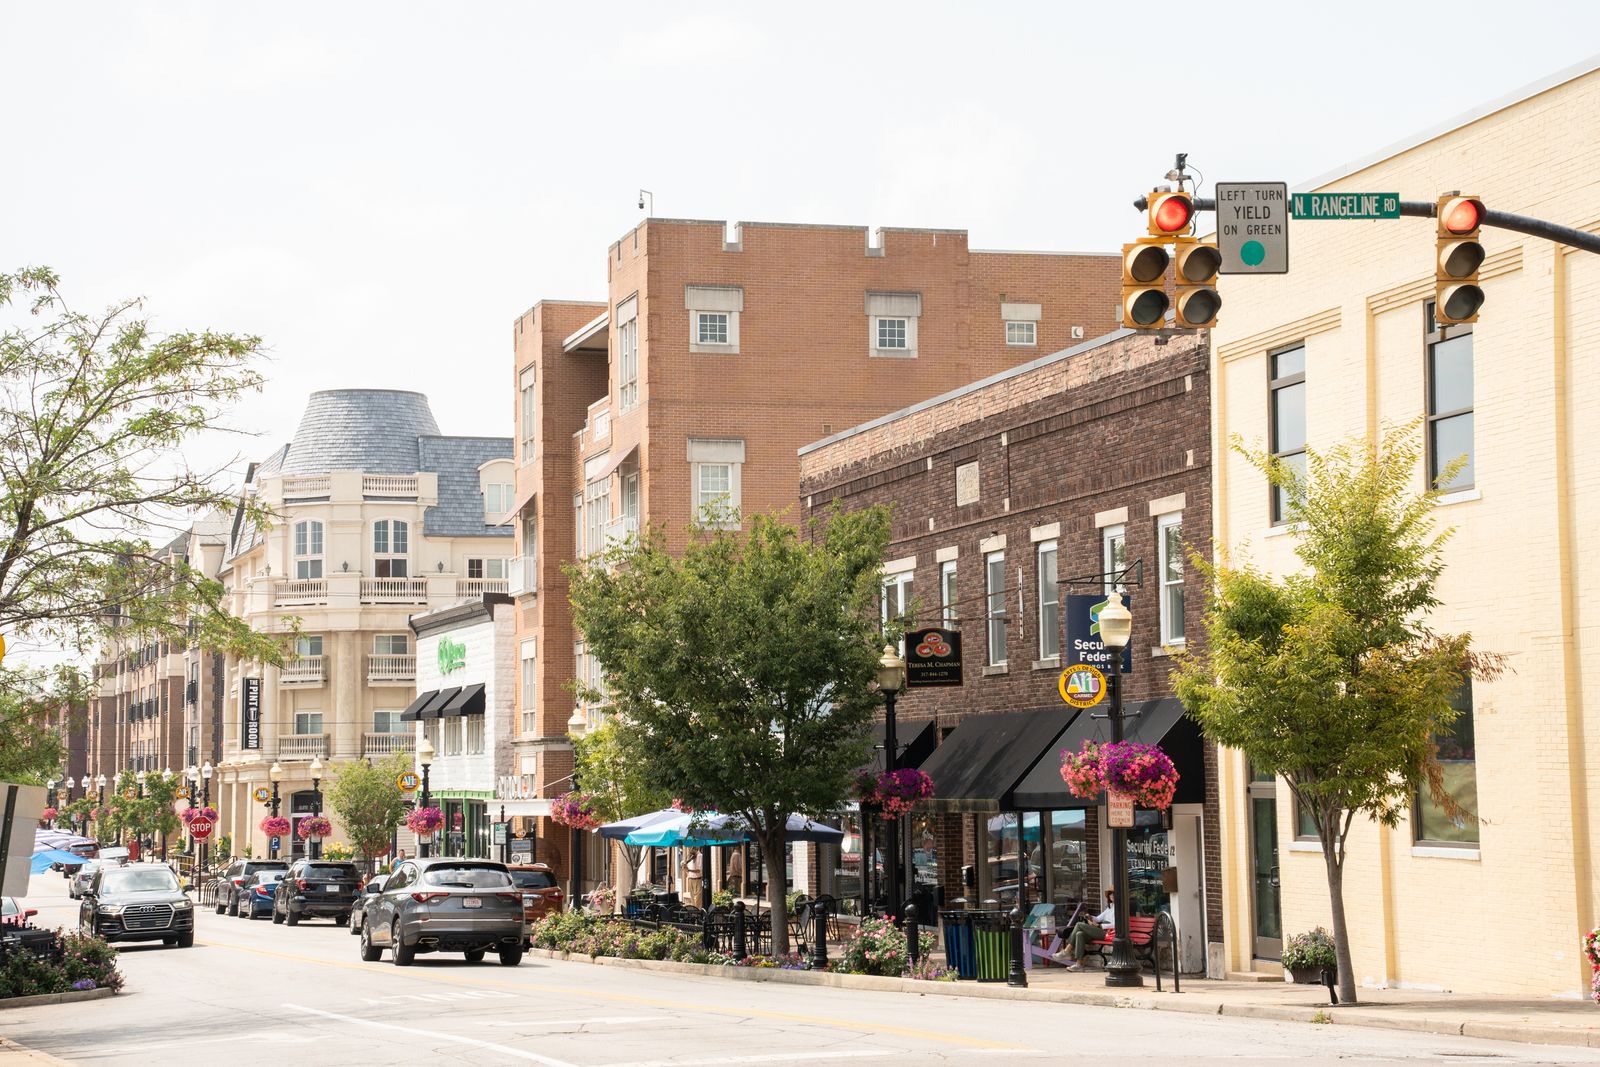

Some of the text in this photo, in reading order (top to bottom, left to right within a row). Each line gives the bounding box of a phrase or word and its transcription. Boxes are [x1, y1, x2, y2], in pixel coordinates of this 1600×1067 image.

[1220, 190, 1283, 201] LEFT TURN
[1294, 195, 1396, 217] N. RANGELINE RD
[1233, 205, 1271, 220] YIELD
[1223, 224, 1282, 236] ON GREEN
[1074, 639, 1103, 650] Secu
[1079, 651, 1112, 662] Feder
[1063, 667, 1076, 679] ARTS
[1081, 665, 1102, 679] DESIGN
[248, 686, 259, 707] PINT
[1069, 698, 1096, 707] DISTRICT
[248, 721, 258, 748] ROOM
[1110, 801, 1132, 809] PARKING
[190, 823, 211, 833] STOP
[272, 837, 279, 846] P
[1127, 839, 1169, 857] Security Fede
[1131, 859, 1155, 870] LENDING
